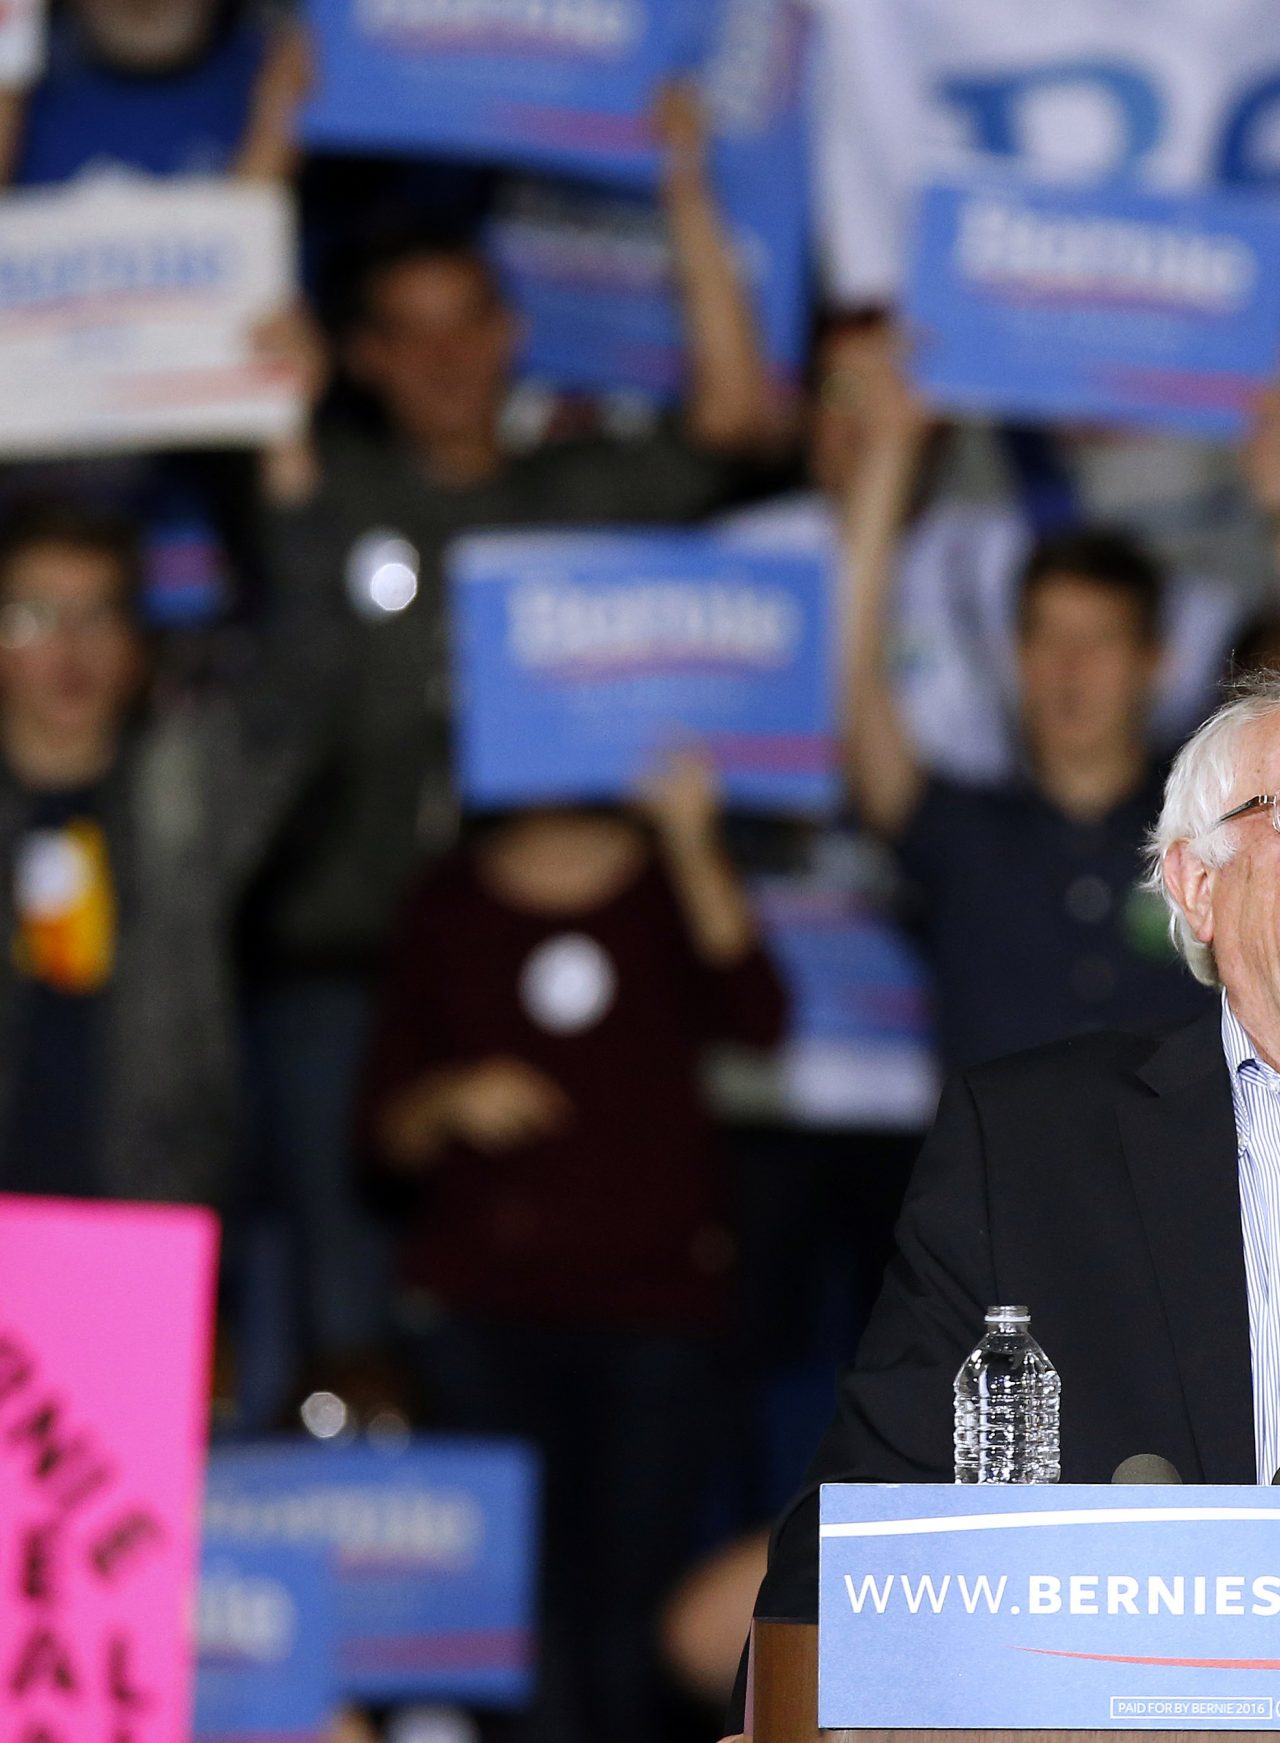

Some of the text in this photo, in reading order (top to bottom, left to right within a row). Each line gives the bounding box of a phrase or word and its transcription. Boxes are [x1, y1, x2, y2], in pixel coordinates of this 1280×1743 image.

[1118, 1702, 1146, 1714] PAID
[1149, 1702, 1173, 1714] FOR
[1174, 1703, 1190, 1714] BY
[1191, 1703, 1234, 1714] BERNIE
[1236, 1703, 1265, 1714] 2016
